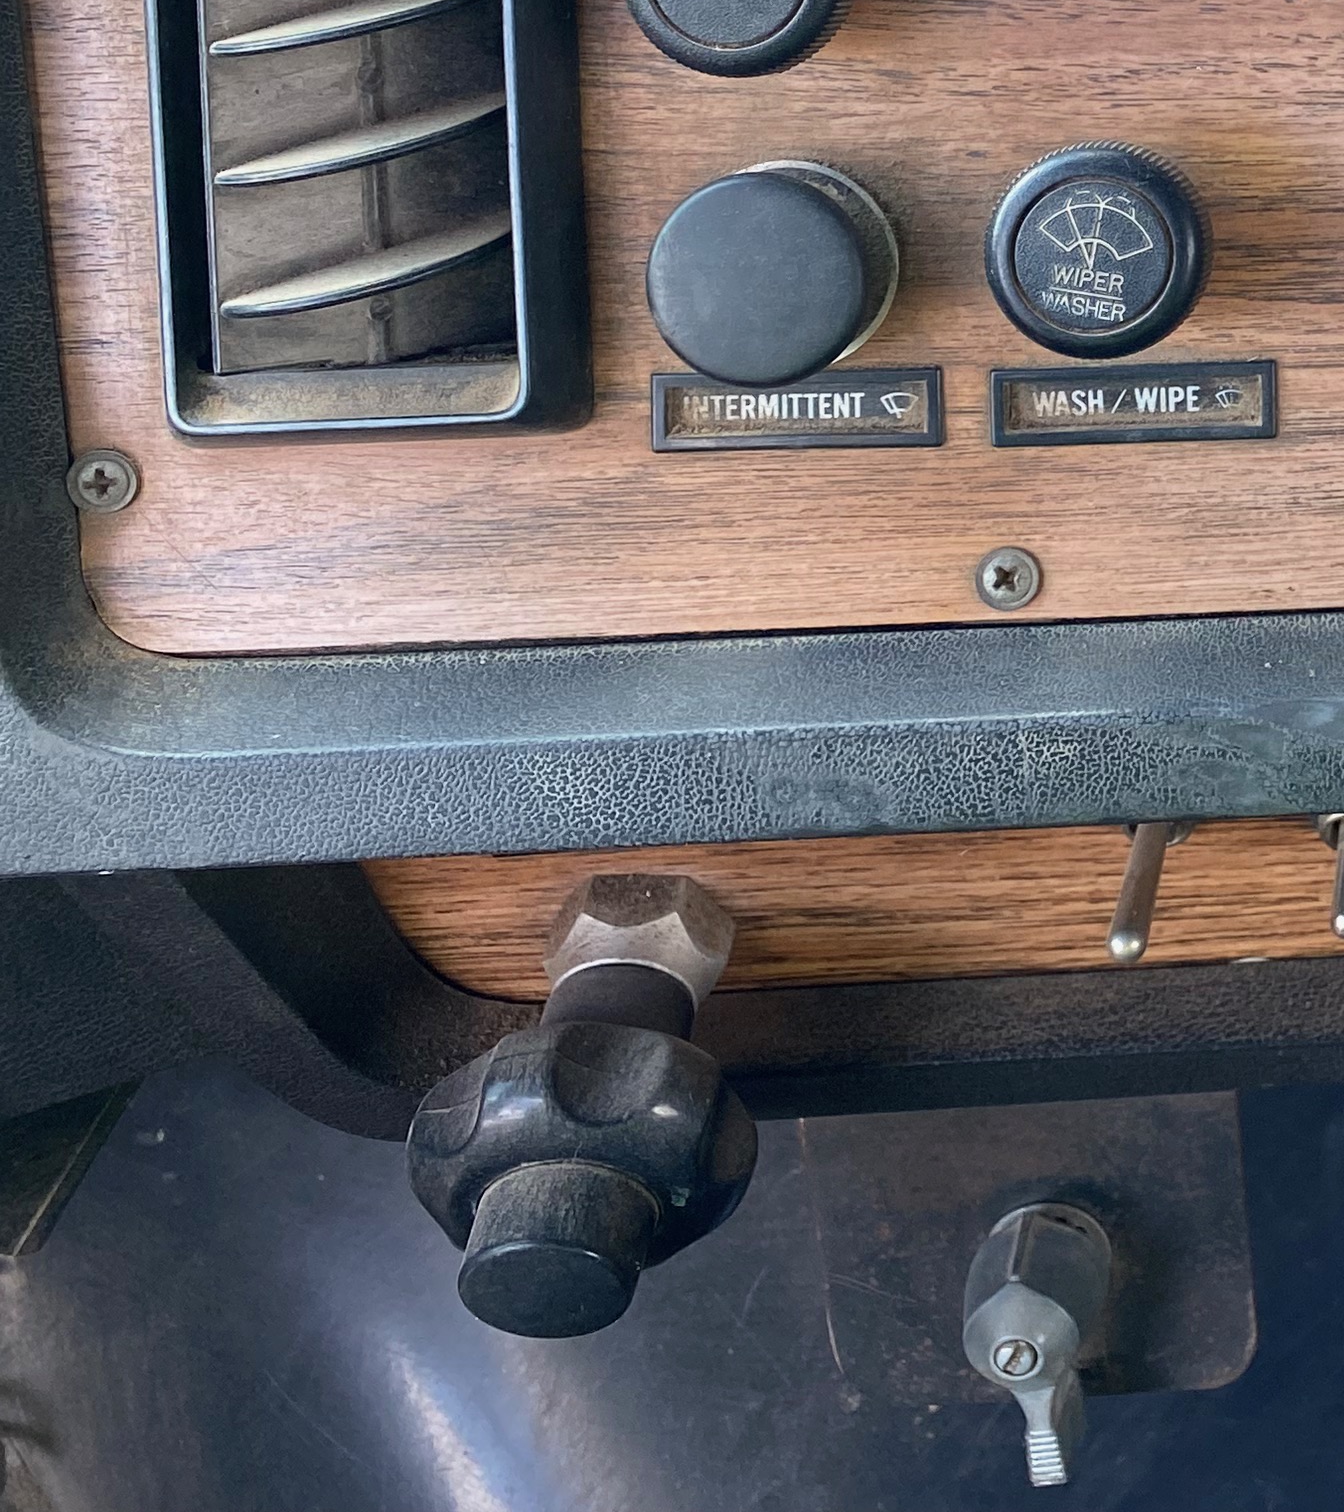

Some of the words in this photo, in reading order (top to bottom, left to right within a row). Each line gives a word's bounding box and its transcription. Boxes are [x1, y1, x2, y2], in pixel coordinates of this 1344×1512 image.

[1053, 265, 1125, 294] WIPER
[1041, 291, 1127, 322] WASHER
[683, 392, 865, 421] INTERMITTENT
[1033, 389, 1104, 417] WASH
[1134, 386, 1200, 413] WIPE
